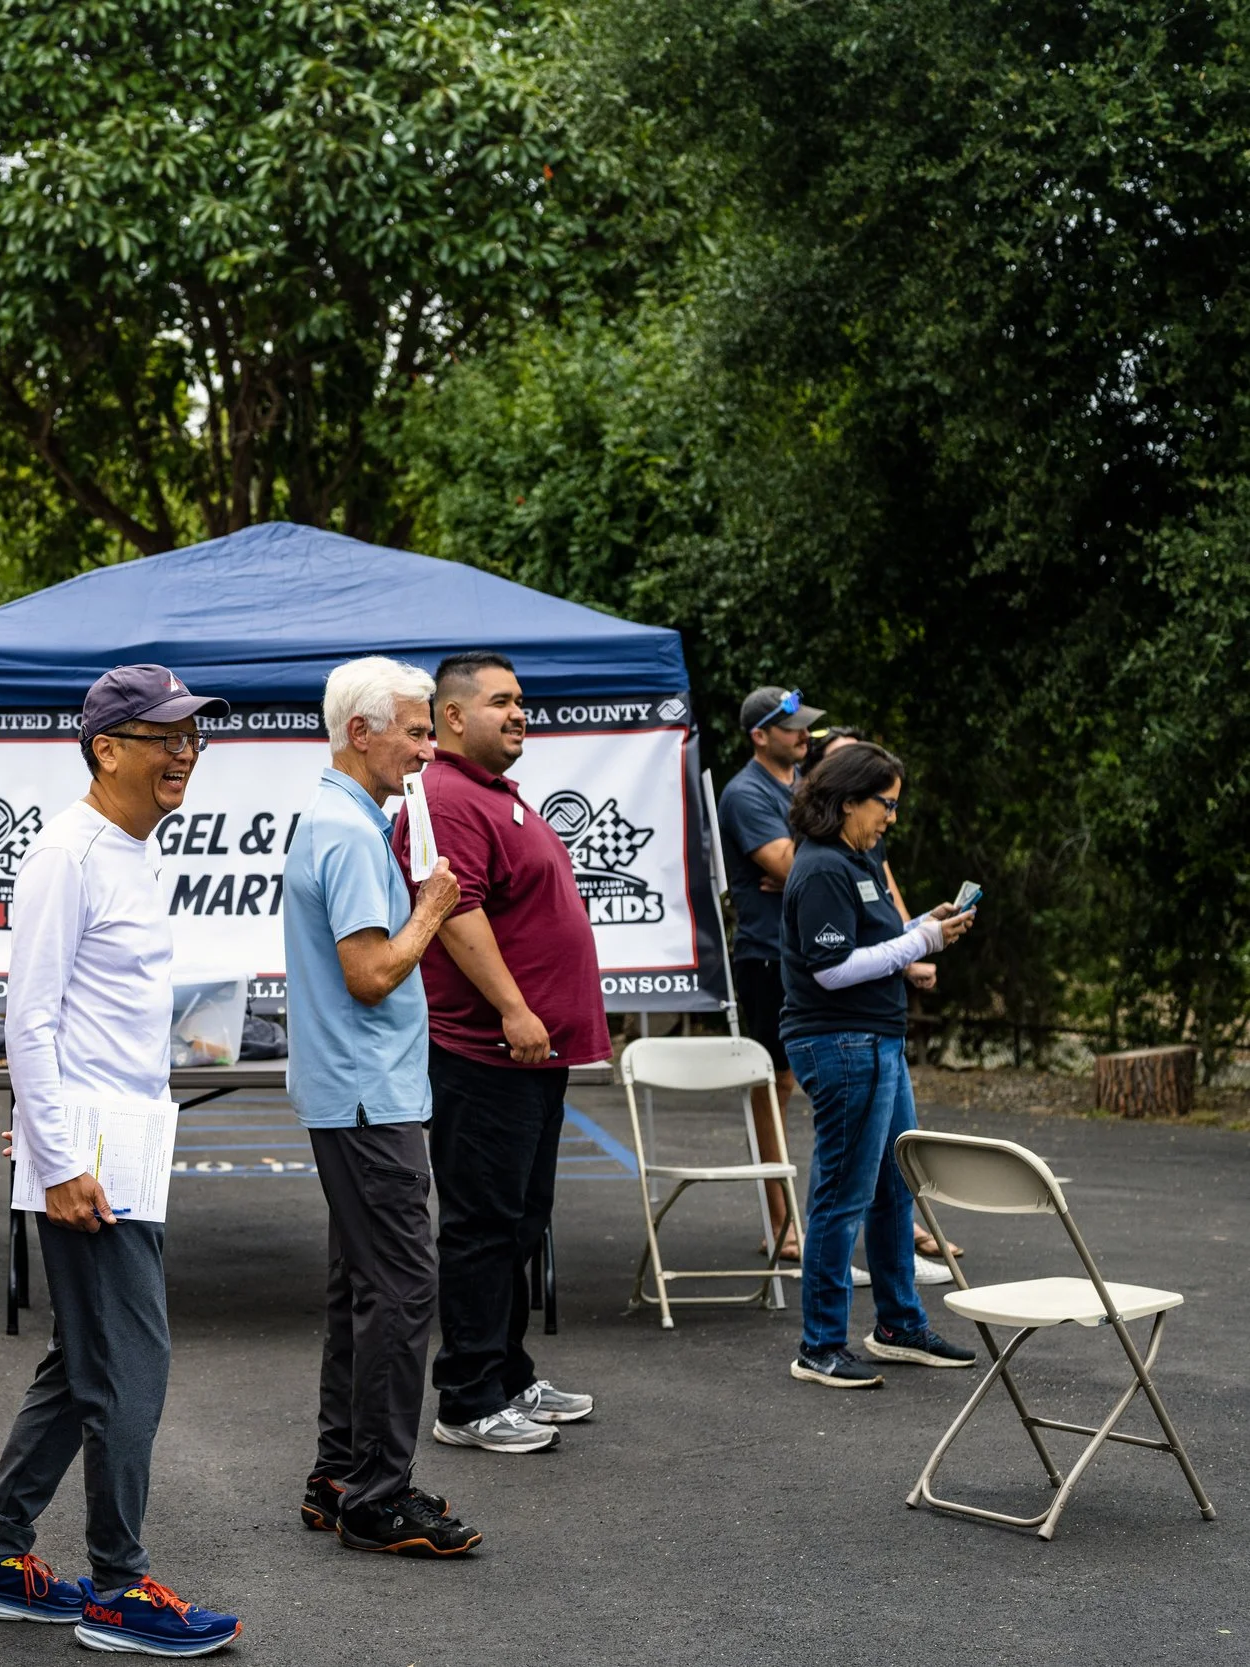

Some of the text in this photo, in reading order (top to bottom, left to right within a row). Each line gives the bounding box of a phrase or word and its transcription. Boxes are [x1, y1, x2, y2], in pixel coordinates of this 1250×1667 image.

[248, 713, 319, 729] CLUBS
[556, 703, 652, 724] COUNTY
[156, 812, 276, 856] GEL &
[596, 887, 635, 896] COUNTY
[599, 880, 625, 888] CLUBS
[589, 894, 664, 923] KIDS
[815, 934, 845, 943] LIAISON
[600, 973, 699, 994] ONSOR!
[83, 1601, 123, 1627] HOKA
